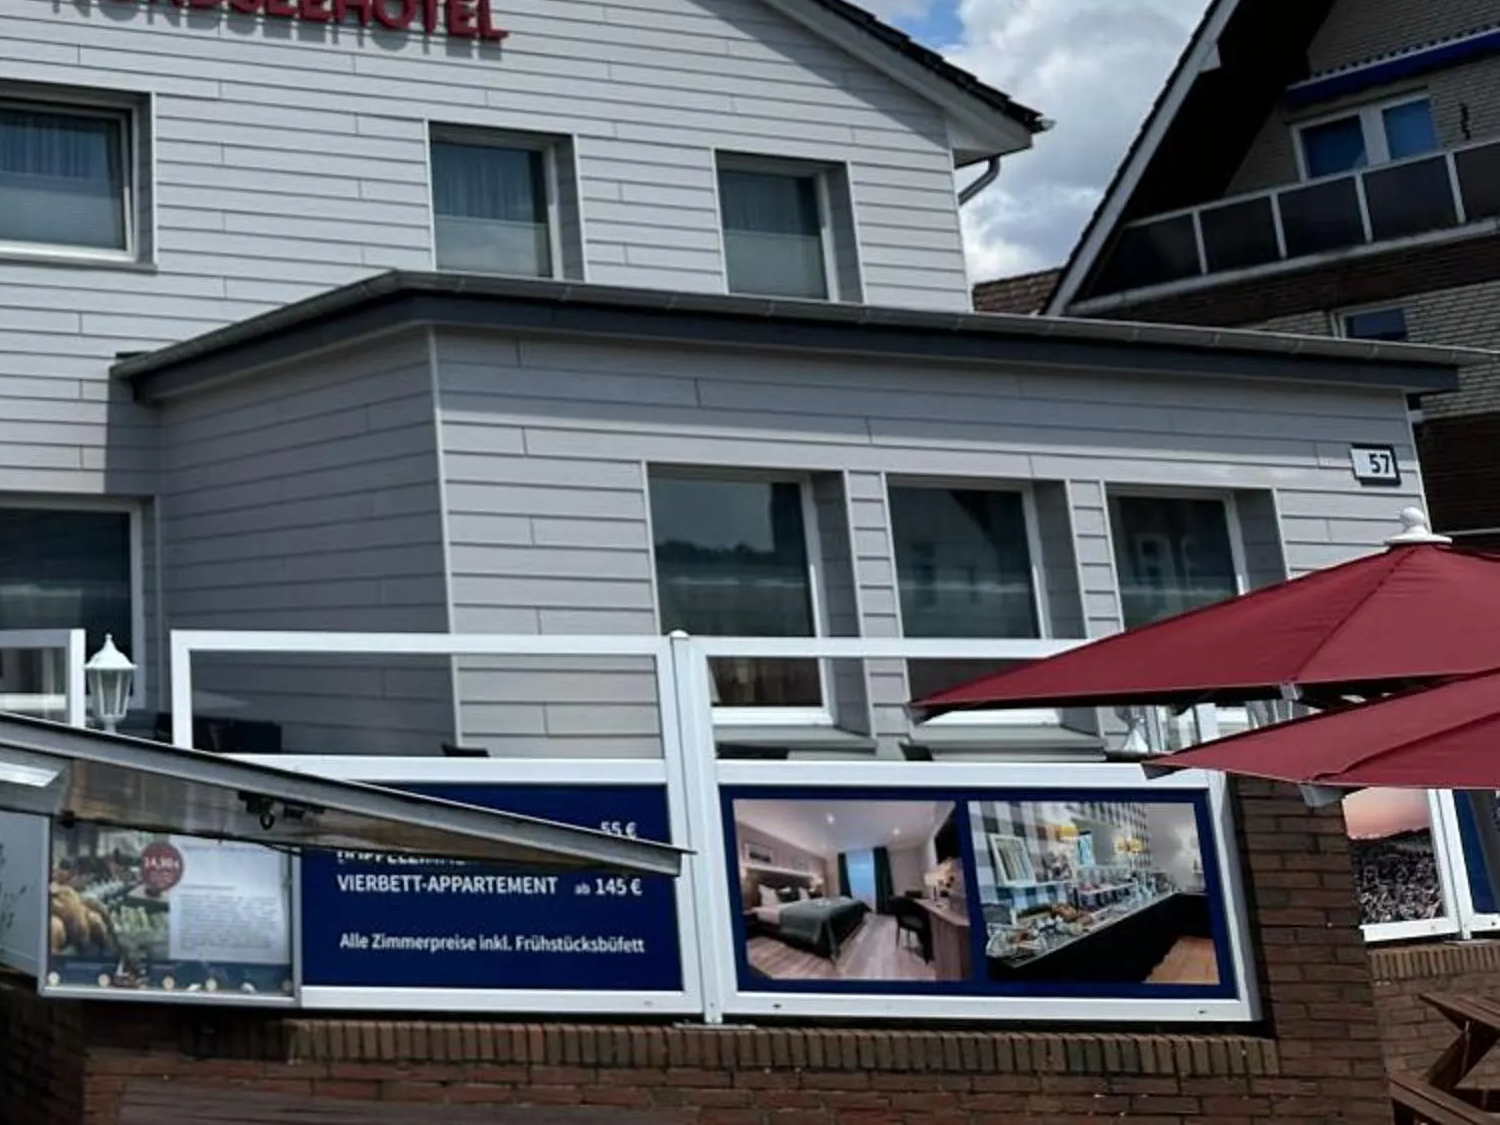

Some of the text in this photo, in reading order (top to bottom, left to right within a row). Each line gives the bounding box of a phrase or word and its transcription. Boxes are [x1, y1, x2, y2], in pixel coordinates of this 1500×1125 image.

[1369, 453, 1389, 474] 57
[337, 874, 643, 896] VIERBETT-APPARTEMENT ab 145 €
[339, 932, 645, 954] Alle Zimmerpreise inkl. Frühstücksbüfett
